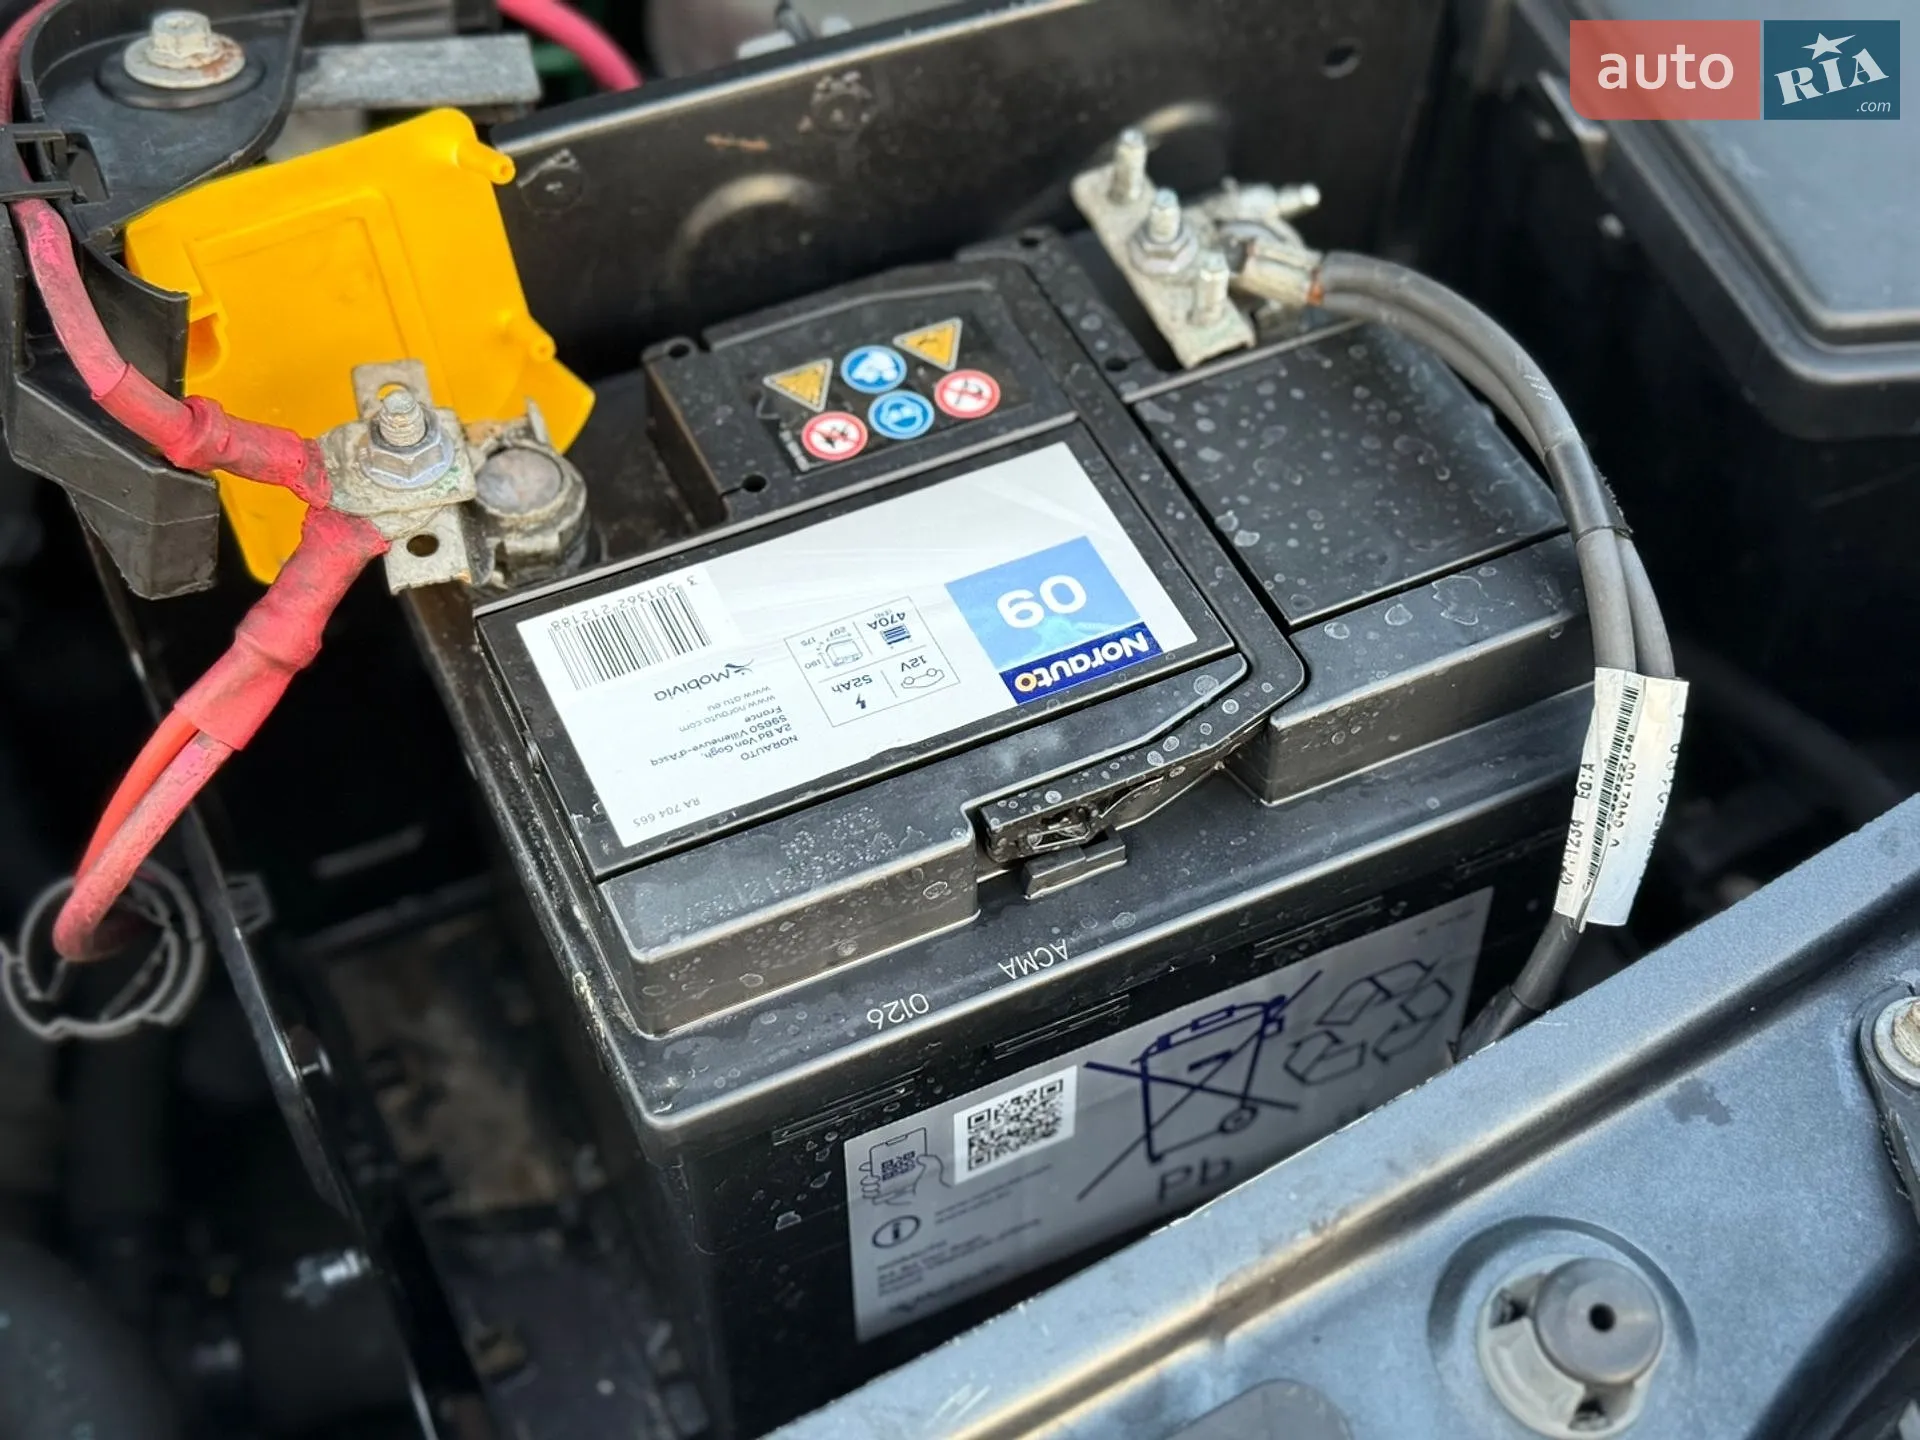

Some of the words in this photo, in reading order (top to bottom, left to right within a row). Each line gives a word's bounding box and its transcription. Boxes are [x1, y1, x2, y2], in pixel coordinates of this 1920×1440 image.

[686, 574, 699, 586] 3
[617, 582, 678, 609] 501362
[997, 574, 1087, 629] 09
[550, 604, 611, 632] 212188
[867, 612, 907, 631] 470A
[829, 626, 846, 637] 207
[800, 636, 816, 647] 175
[901, 654, 927, 672] 12V
[1014, 631, 1149, 692] Norauto
[654, 668, 731, 702] Mobivia
[832, 674, 873, 693] 52Ah
[707, 686, 771, 711] www.atu.eu
[679, 695, 776, 733] www.norauto.com
[744, 706, 783, 723] France
[750, 714, 788, 733] 59650
[758, 730, 774, 741] Bd
[775, 723, 792, 735] 2A
[650, 729, 748, 766] Villeneuve-d'Ascq
[701, 744, 733, 759] Gogh,
[735, 737, 758, 749] Van
[741, 734, 799, 761] NORAUTO
[659, 804, 681, 818] 704
[683, 797, 701, 809] RA
[633, 815, 655, 827] 665
[998, 939, 1069, 980] ACMA
[867, 993, 930, 1030] 0126
